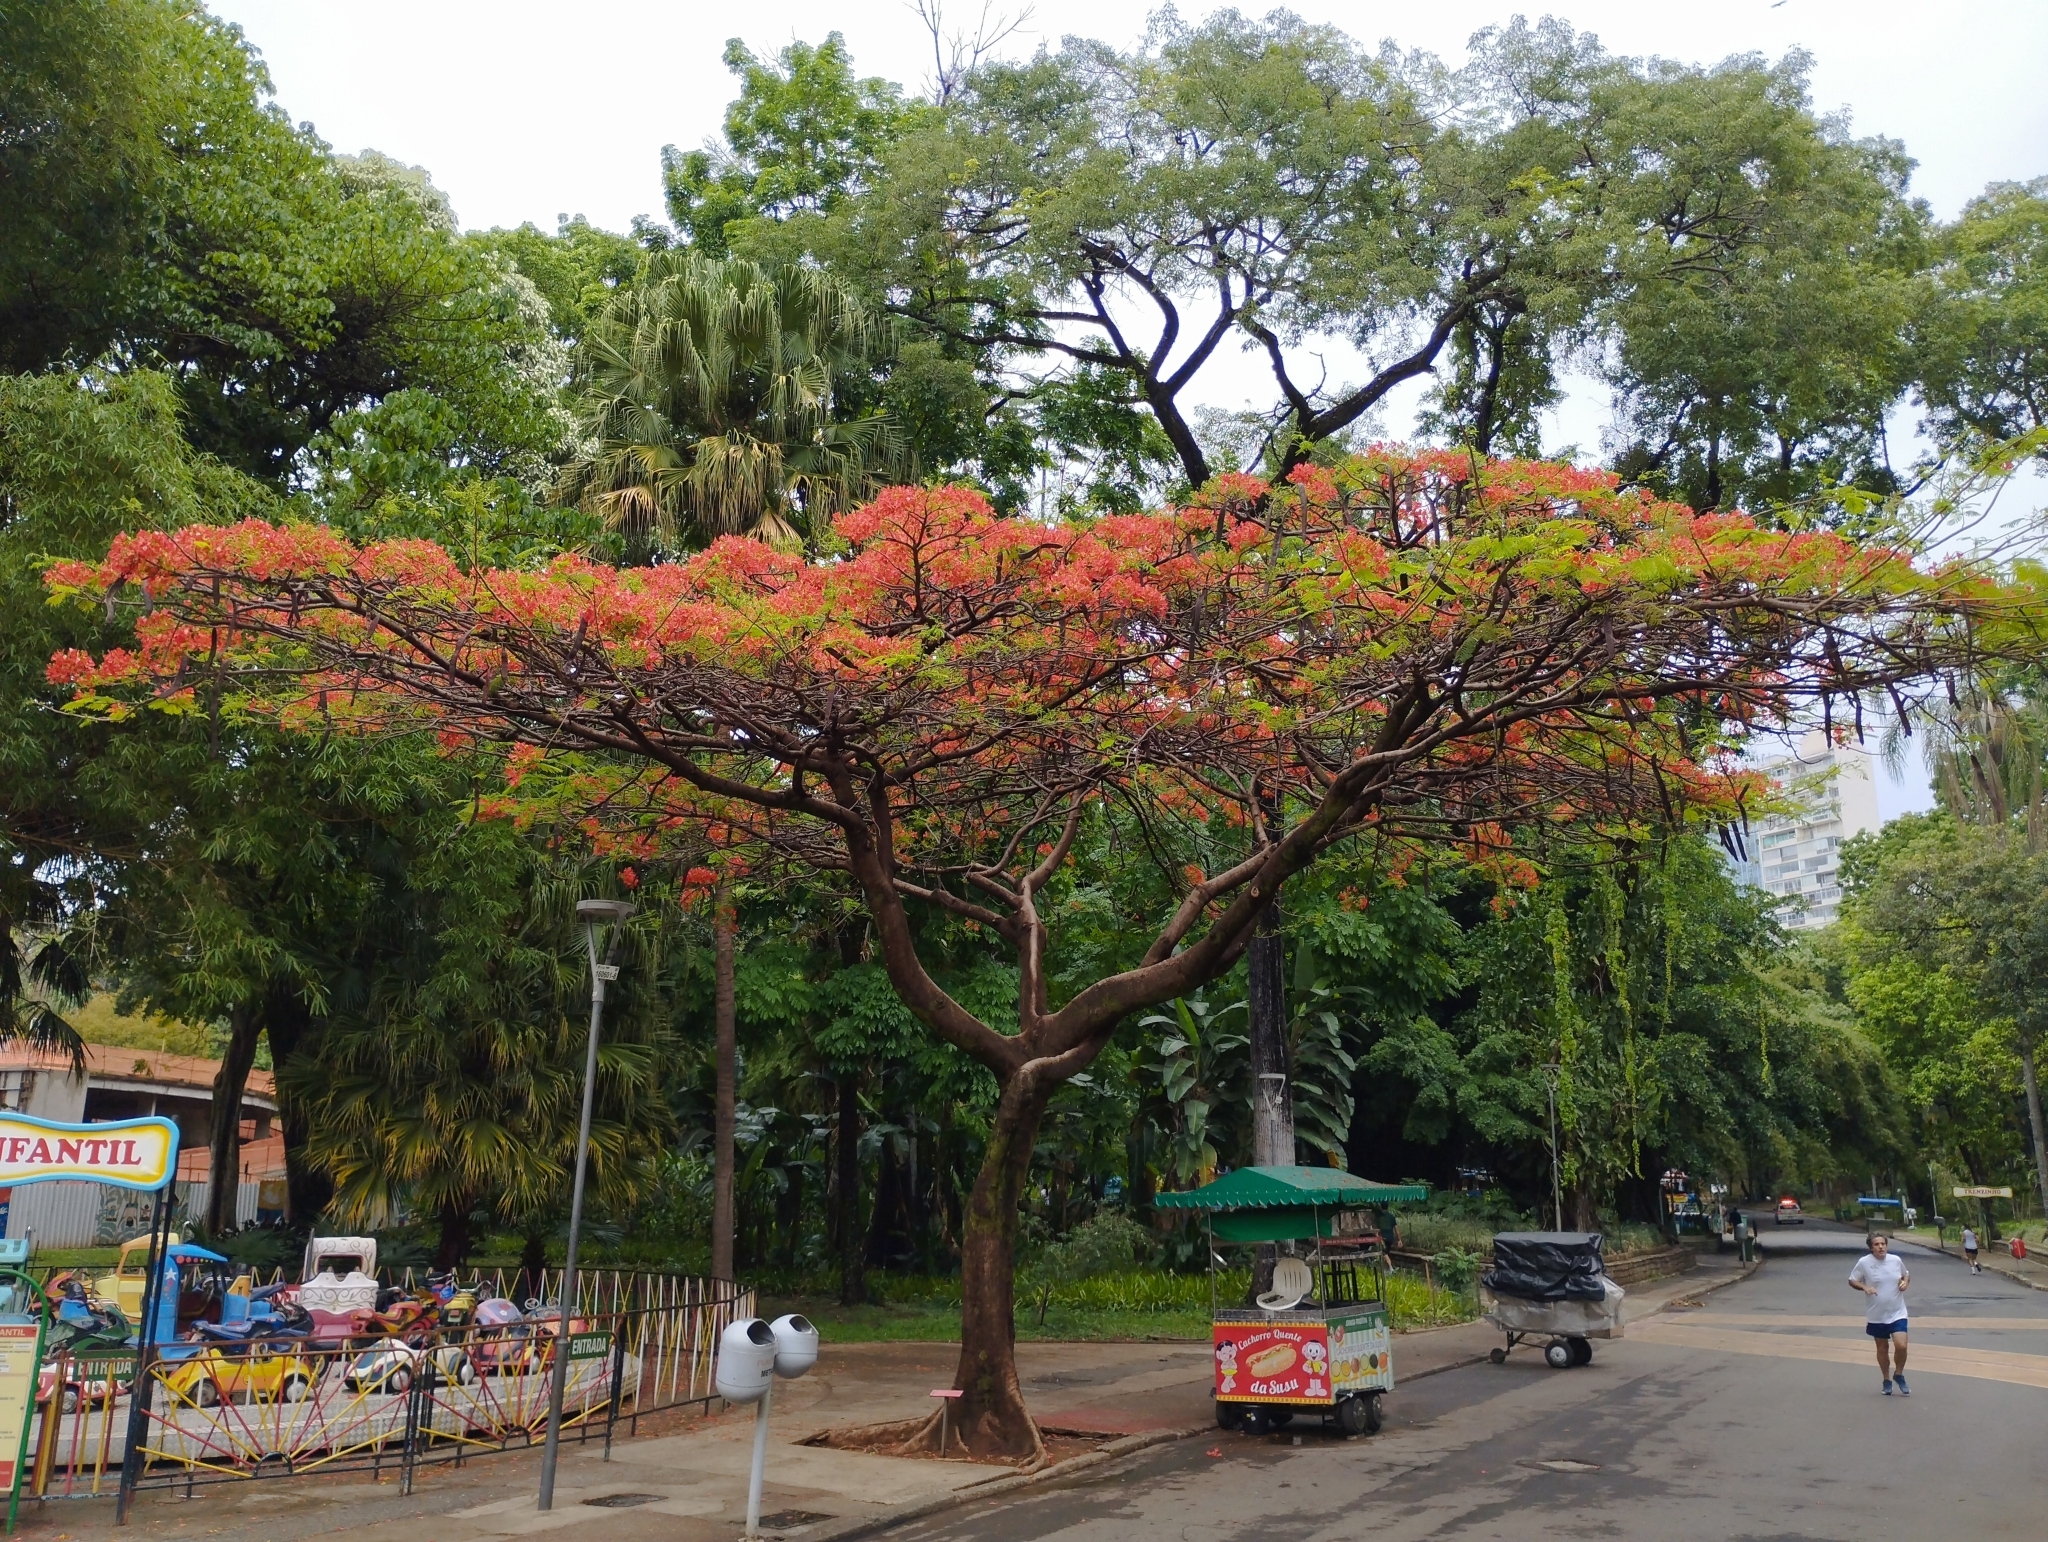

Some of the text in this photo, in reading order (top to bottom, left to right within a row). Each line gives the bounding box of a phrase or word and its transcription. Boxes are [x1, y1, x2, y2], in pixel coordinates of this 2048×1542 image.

[0, 1137, 141, 1165] FANTIL
[571, 1337, 606, 1355] ENTRADA
[1238, 1329, 1302, 1350] Cachorro Quente
[1250, 1379, 1299, 1394] da Susu
